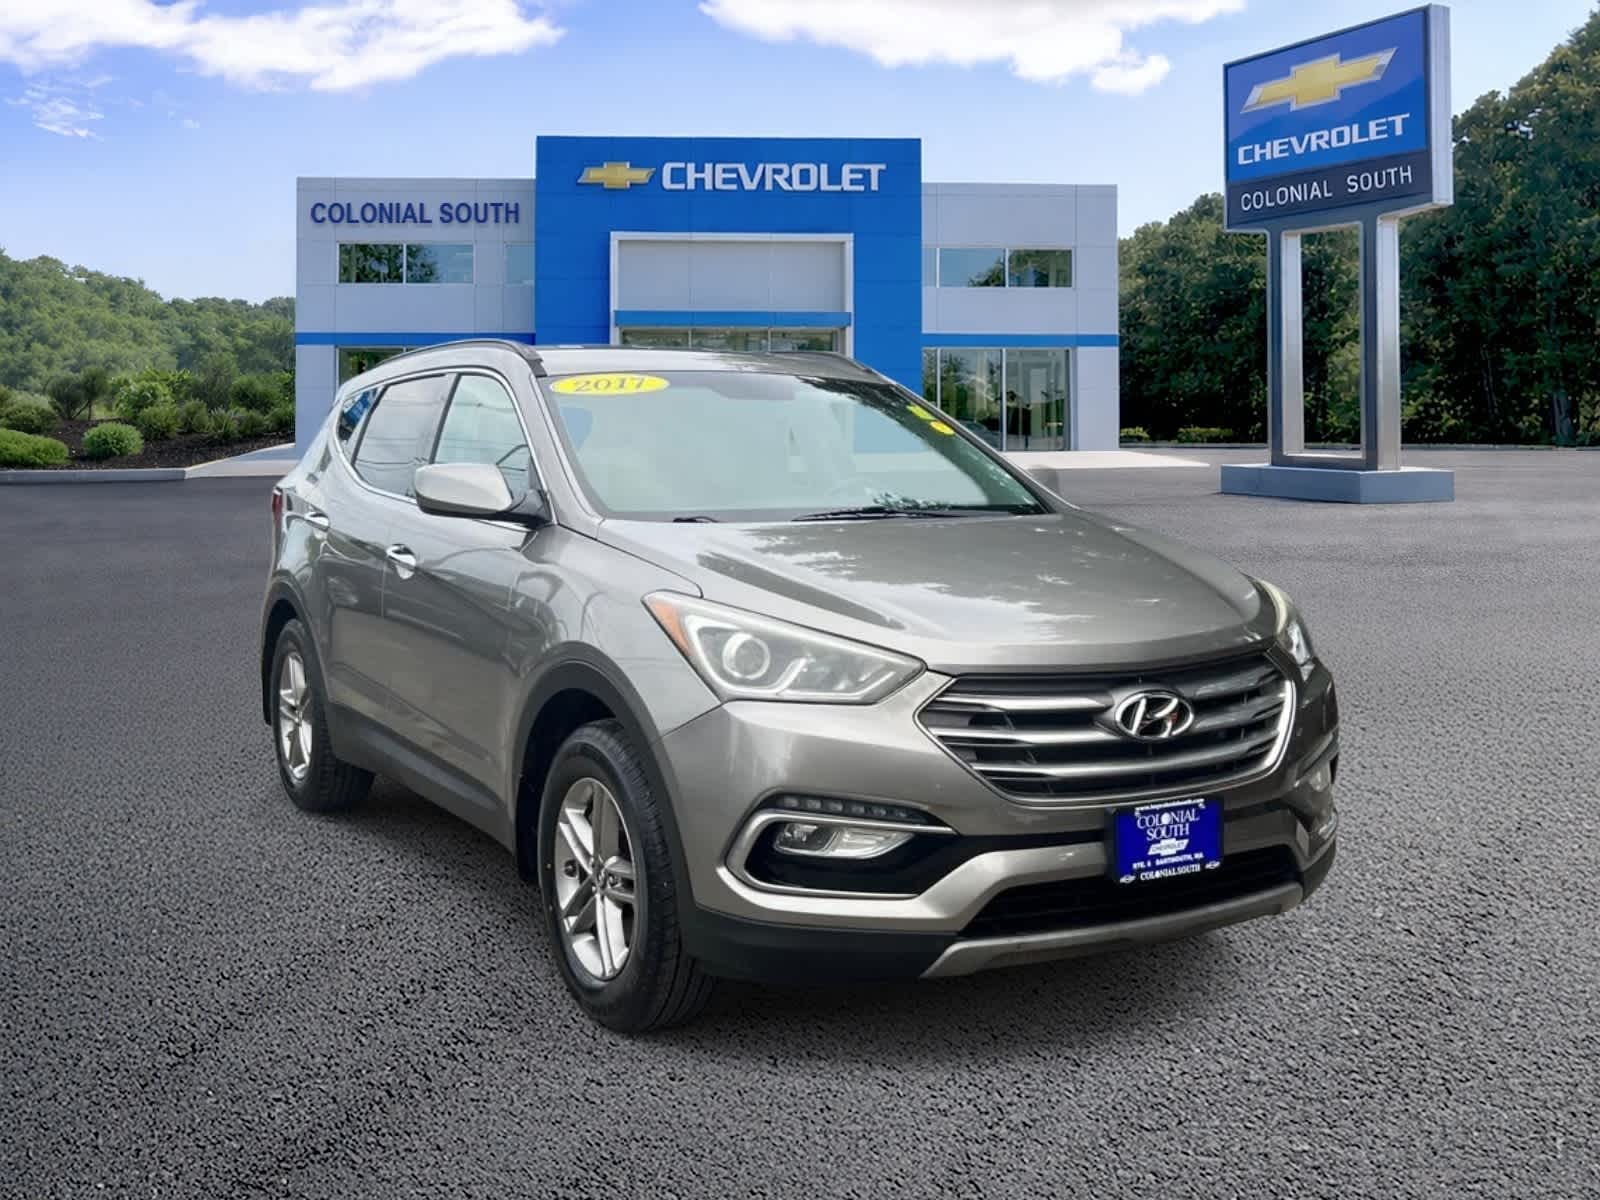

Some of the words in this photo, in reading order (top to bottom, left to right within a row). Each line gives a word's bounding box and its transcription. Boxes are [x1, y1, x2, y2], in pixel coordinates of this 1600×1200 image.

[1237, 113, 1410, 165] CHEVROLET
[661, 162, 887, 193] CHEVROLET
[1241, 180, 1333, 211] COLONIAL
[1347, 165, 1413, 193] SOUTH
[310, 202, 434, 225] COLONIAL
[439, 202, 521, 225] SOUTH
[574, 378, 647, 392] 2017
[1137, 808, 1200, 829] COLONIAL
[1146, 823, 1190, 841] SOUTH
